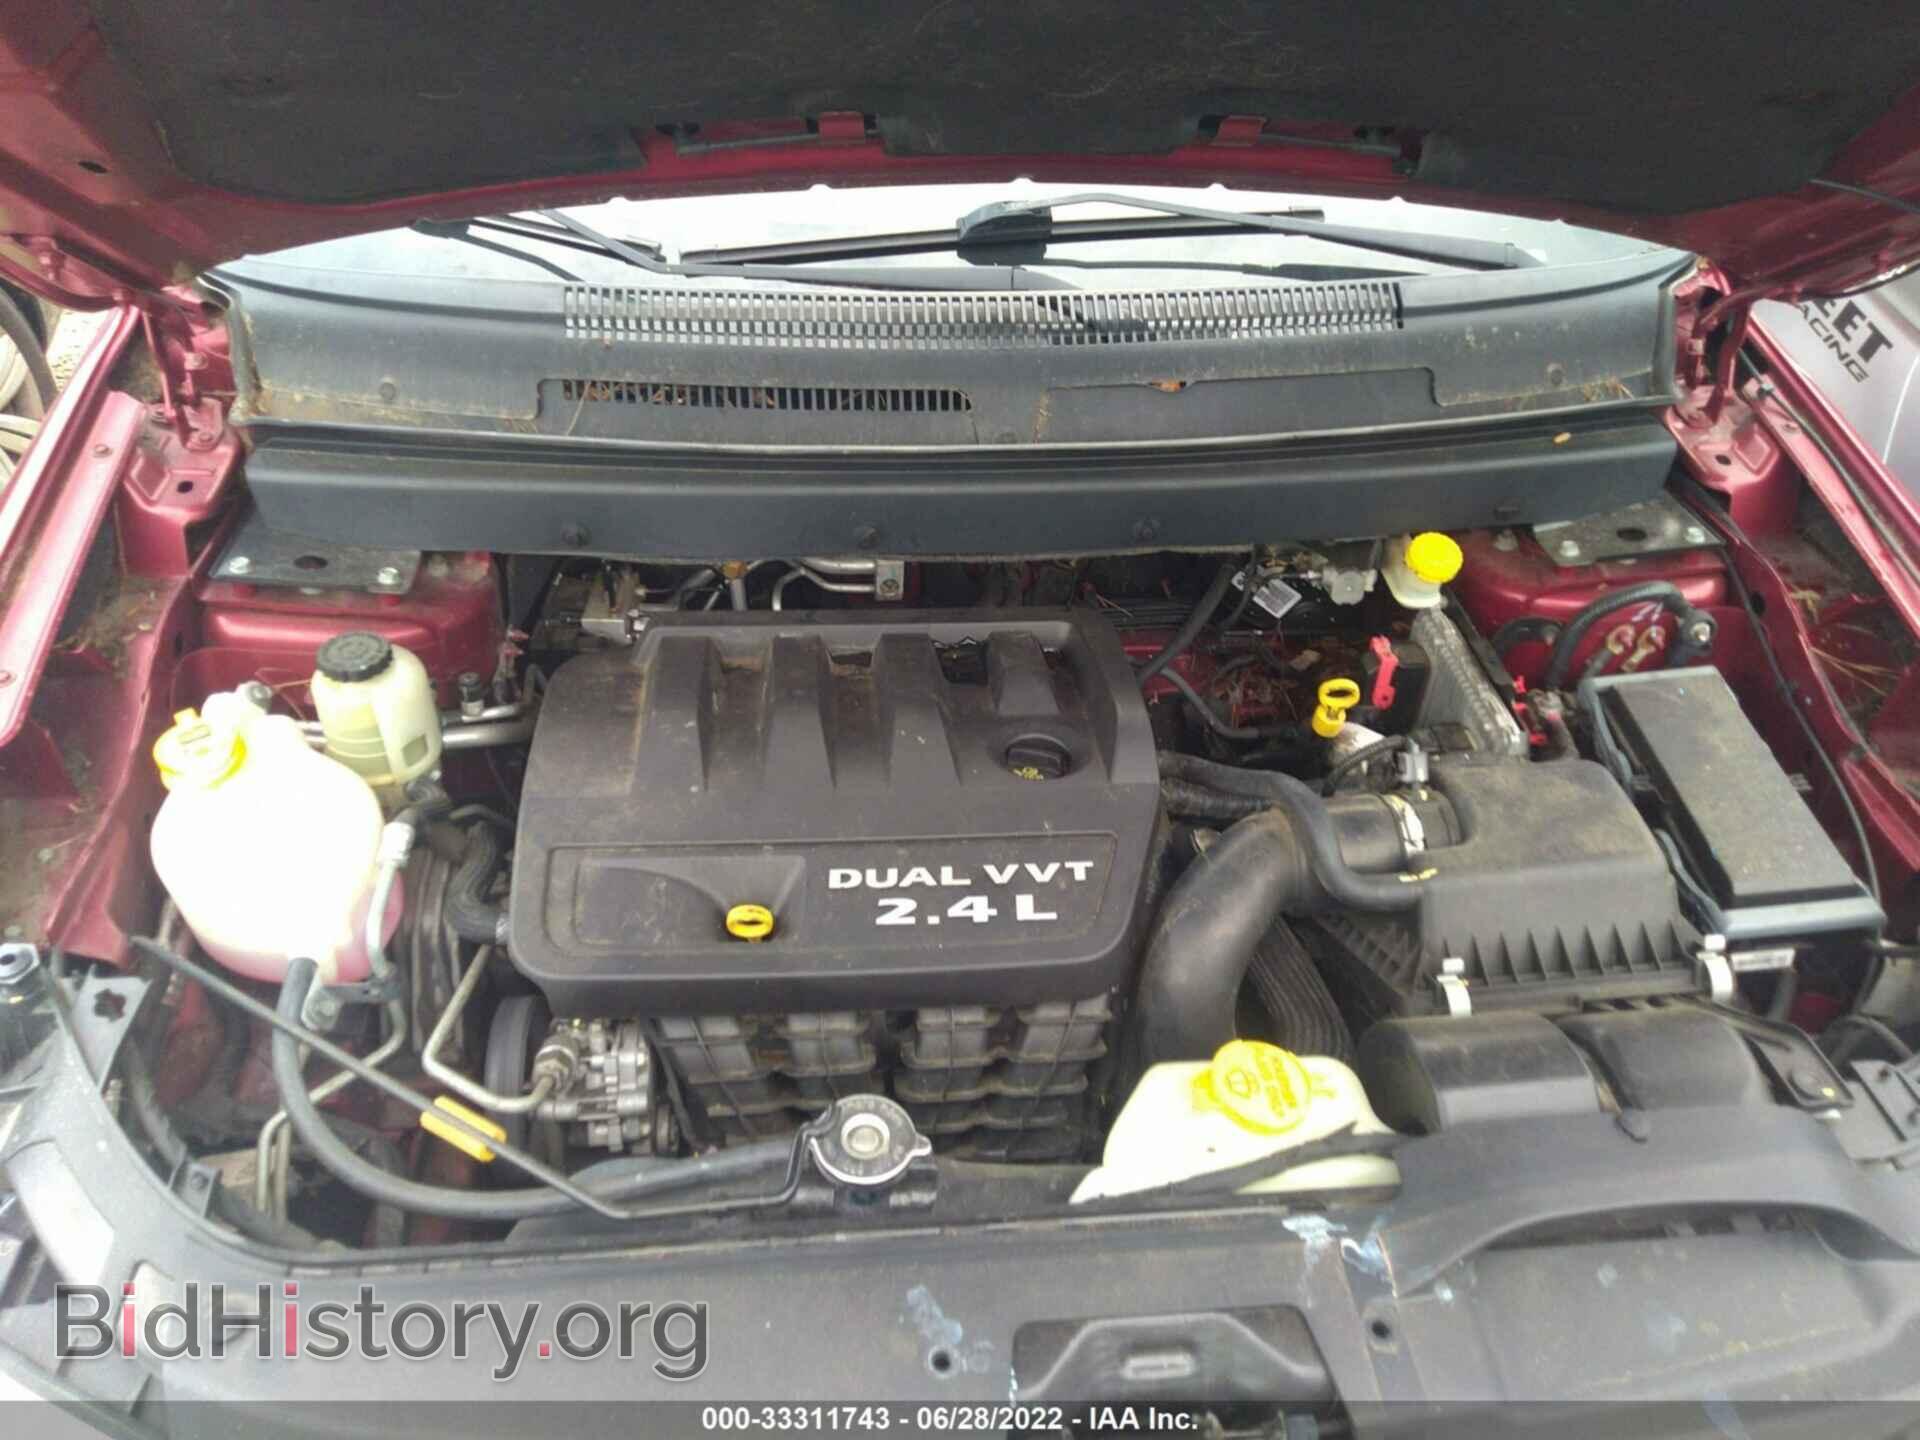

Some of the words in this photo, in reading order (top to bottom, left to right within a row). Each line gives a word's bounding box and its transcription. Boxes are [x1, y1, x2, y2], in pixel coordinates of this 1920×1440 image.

[828, 865, 972, 889] DUAL
[982, 861, 1094, 885] VVT
[874, 895, 998, 925] 2.4
[1015, 894, 1058, 921] L
